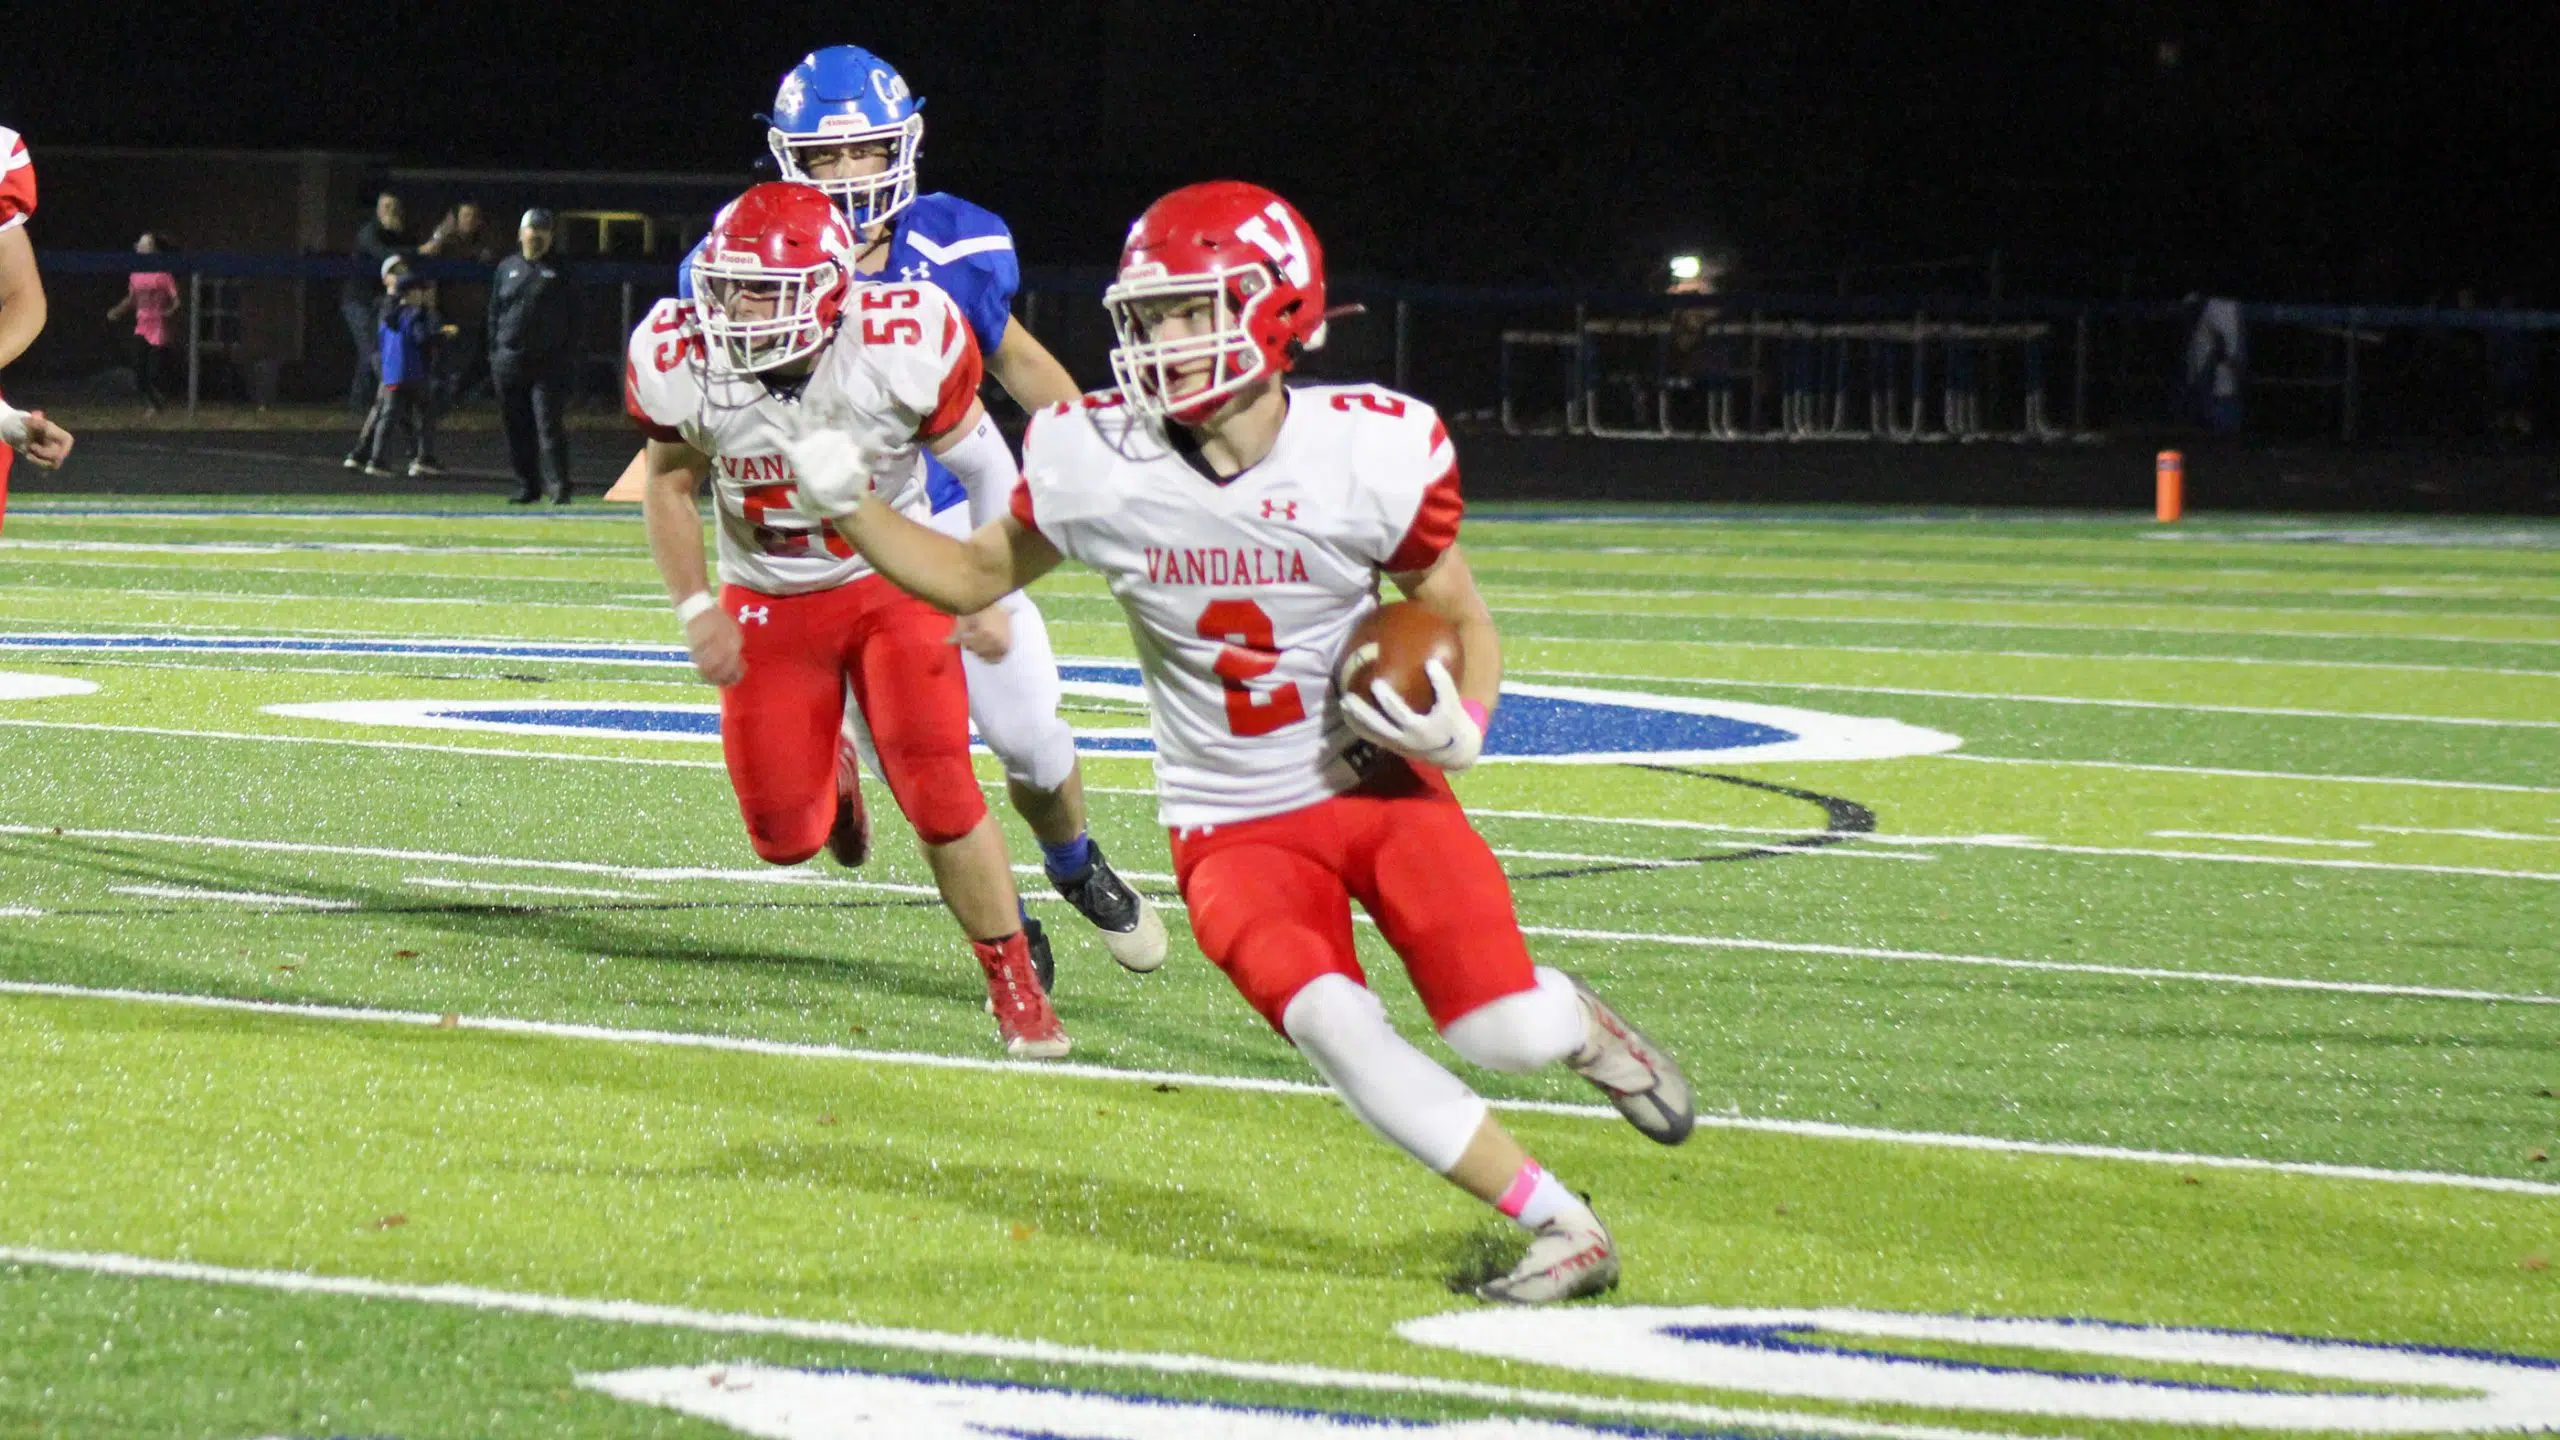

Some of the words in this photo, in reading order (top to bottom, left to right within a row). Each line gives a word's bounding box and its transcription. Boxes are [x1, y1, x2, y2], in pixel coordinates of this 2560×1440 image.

[1237, 202, 1311, 289] V
[861, 289, 921, 345] 55
[1330, 393, 1406, 419] 2
[1144, 547, 1310, 585] VANDALIA
[1196, 598, 1306, 737] 2
